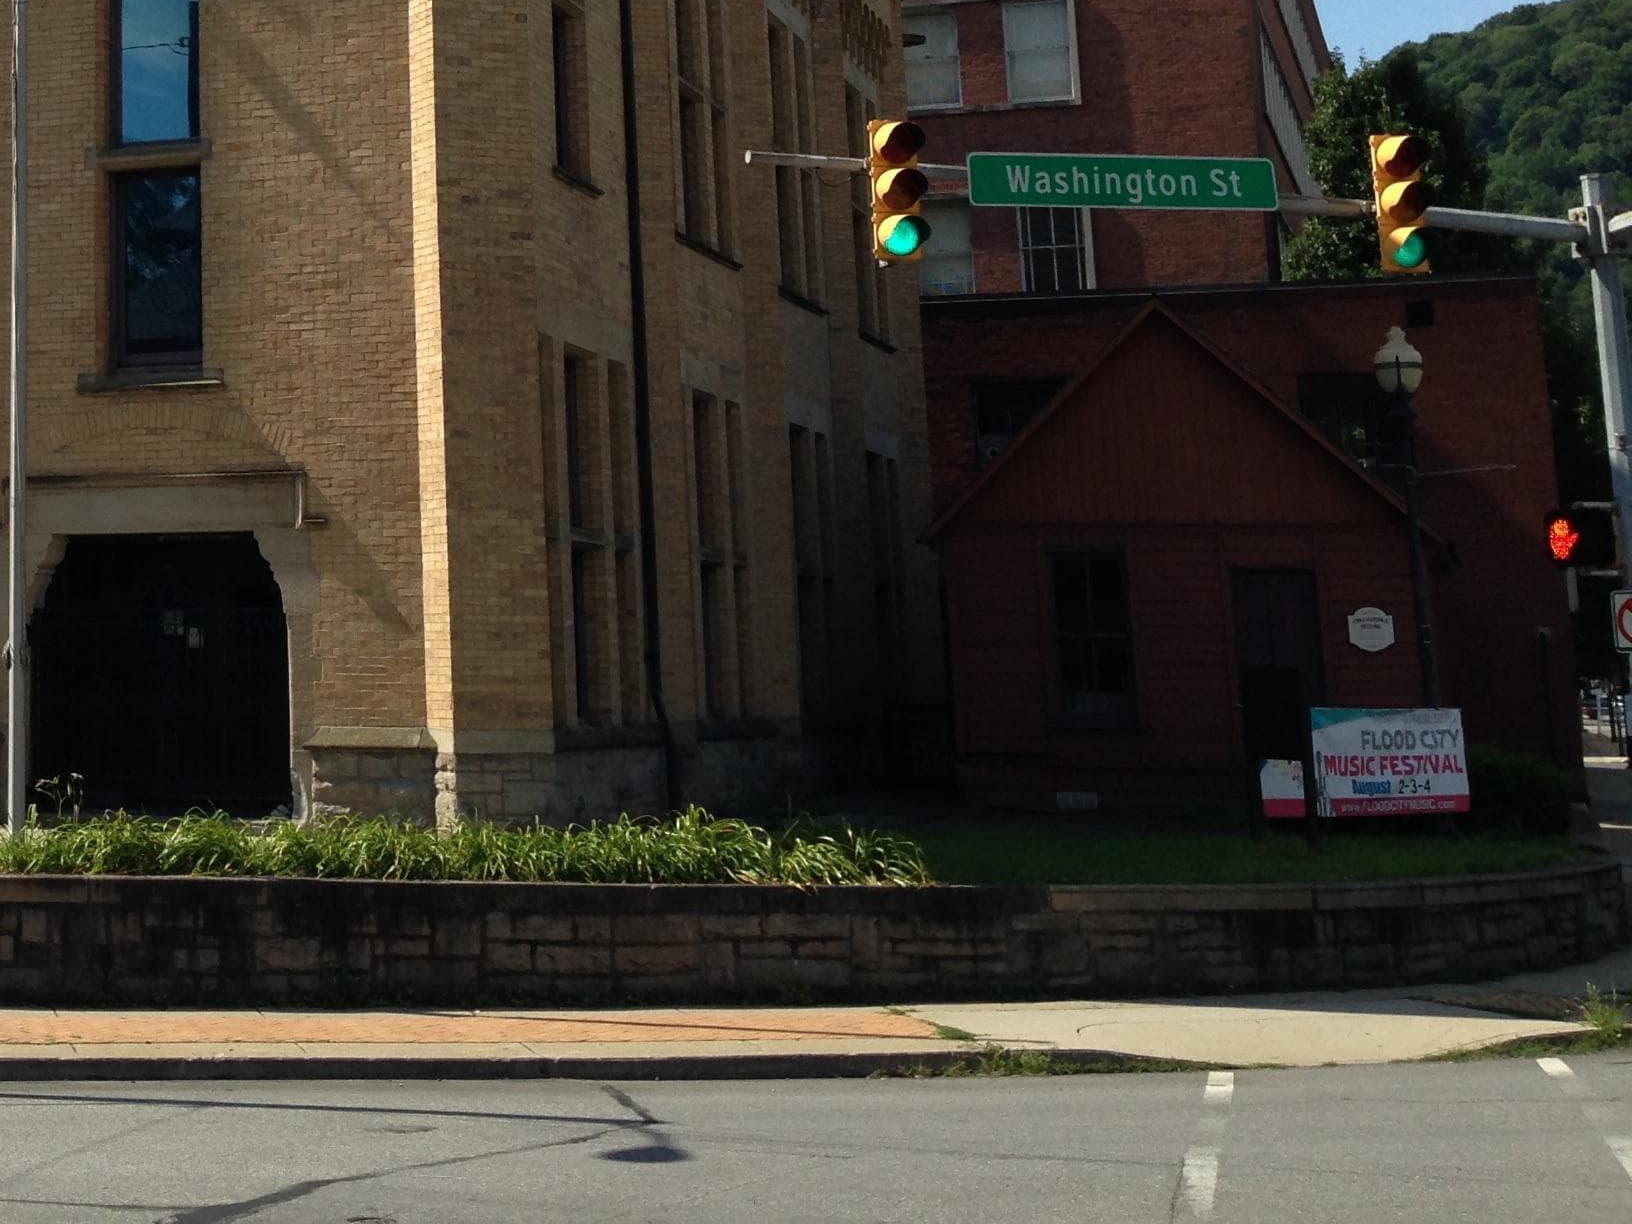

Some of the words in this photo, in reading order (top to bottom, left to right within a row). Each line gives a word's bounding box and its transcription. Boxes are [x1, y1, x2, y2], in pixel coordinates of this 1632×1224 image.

[1005, 164, 1198, 204] Washington
[1209, 168, 1243, 197] St
[1360, 729, 1416, 751] FLOOD
[1420, 729, 1459, 751] CITY
[1323, 755, 1376, 777] MUSIC
[1380, 754, 1463, 776] FESTIVAL
[1352, 779, 1391, 796] August
[1398, 779, 1431, 794] 2-3-4
